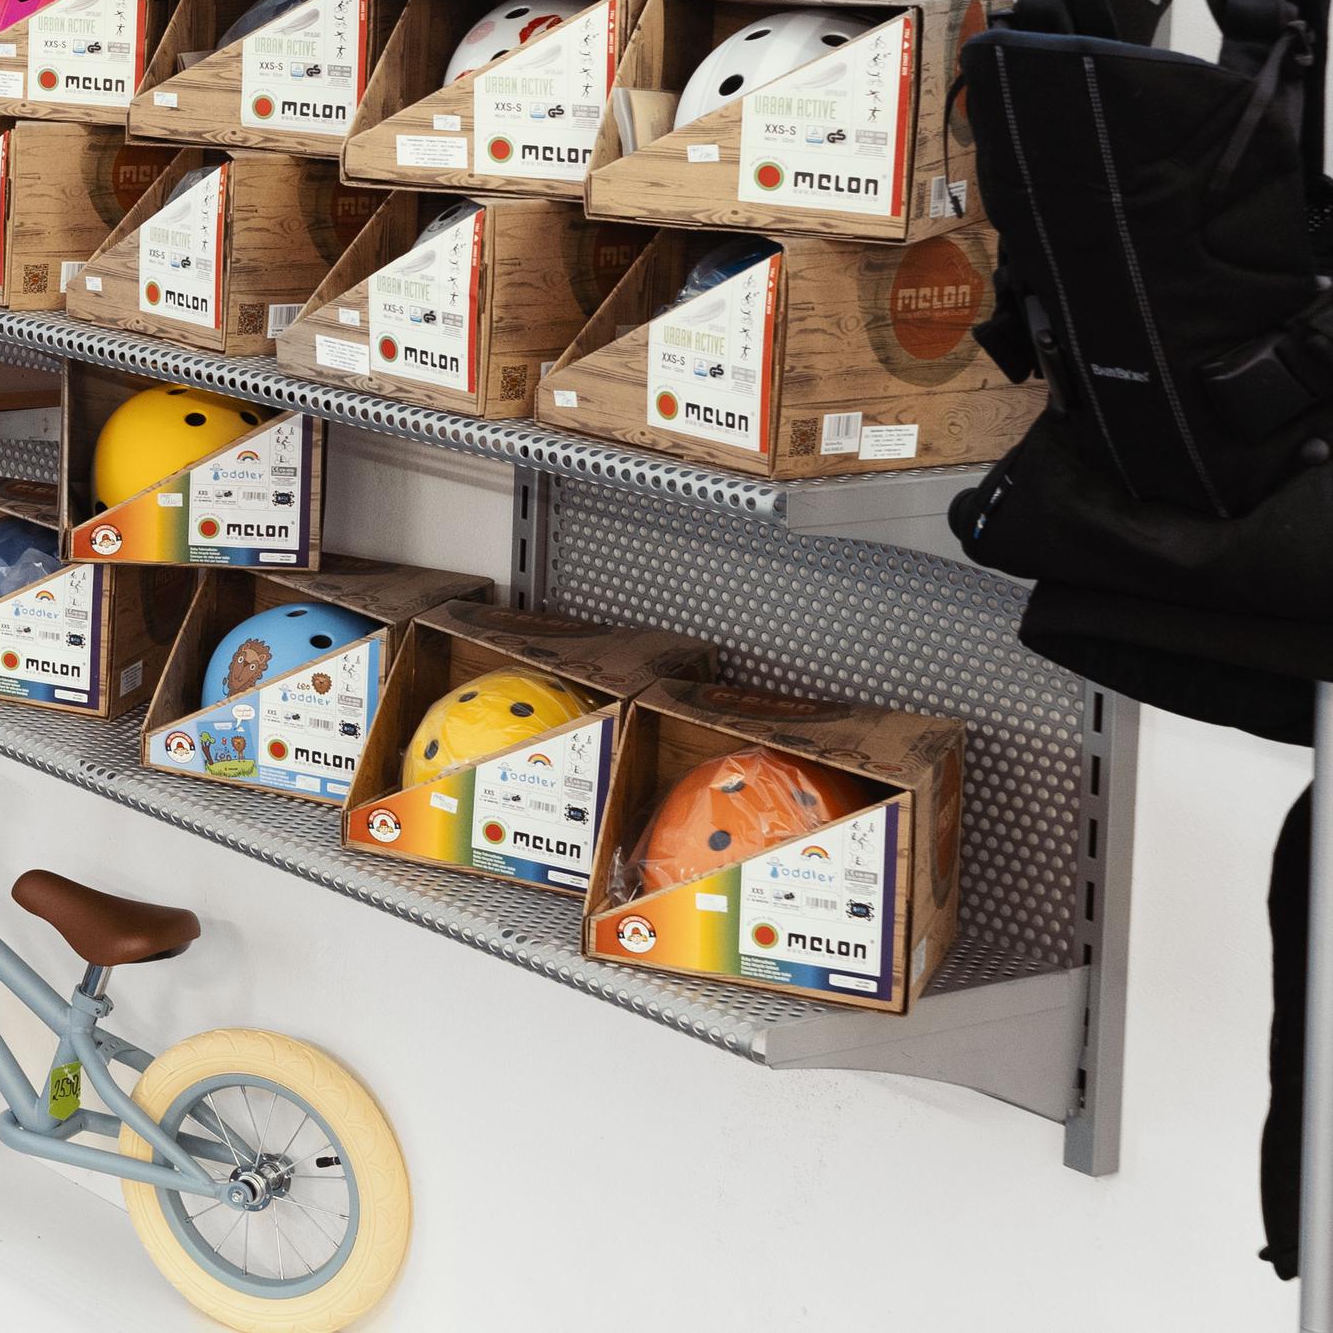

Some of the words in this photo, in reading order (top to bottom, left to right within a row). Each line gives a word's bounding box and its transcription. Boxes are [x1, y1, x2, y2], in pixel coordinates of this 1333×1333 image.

[44, 40, 67, 49] XXS-S
[254, 37, 284, 55] URBAN
[286, 39, 317, 57] ACTIVE
[259, 61, 283, 71] XXS-S
[65, 75, 125, 93] MELON
[484, 75, 518, 94] URBAN
[521, 78, 555, 96] ACTIVE
[282, 101, 346, 120] MELON
[494, 102, 522, 112] XXS-S
[754, 94, 792, 116] URBAN
[797, 97, 837, 120] ACTIVE
[764, 123, 797, 136] XXS-S
[793, 170, 879, 196] MELON
[165, 290, 208, 313] MELON
[896, 283, 972, 312] MELON
[382, 302, 404, 315] XXS-S
[663, 324, 692, 347] URBAN
[694, 329, 725, 356] ACTIVE
[404, 346, 460, 373] MELON
[661, 351, 686, 367] XXS-S
[685, 401, 749, 433] MELON
[226, 523, 289, 538] MELON
[25, 657, 81, 678] MELON
[294, 747, 355, 771] MELON
[513, 831, 581, 859] MELON
[787, 932, 866, 960] MELON
